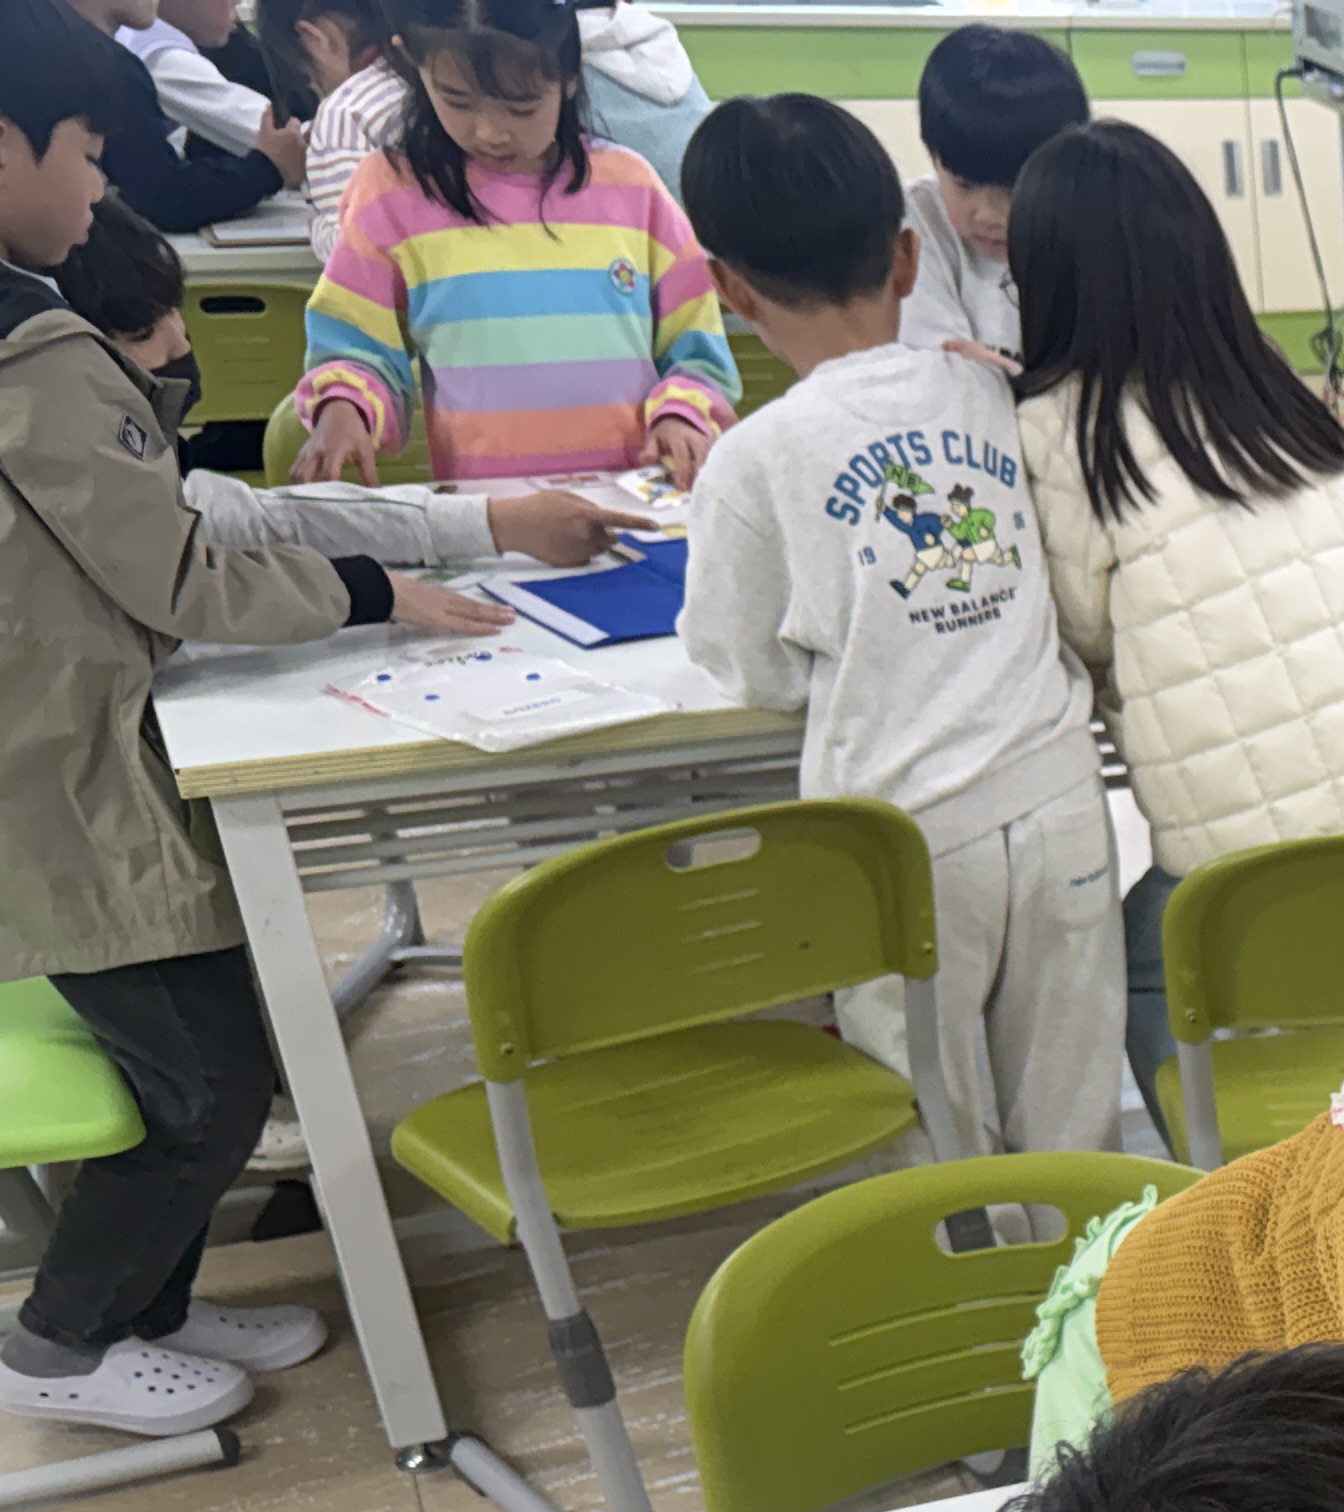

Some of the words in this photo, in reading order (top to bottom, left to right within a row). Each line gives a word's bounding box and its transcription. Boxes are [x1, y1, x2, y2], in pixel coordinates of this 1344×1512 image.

[826, 430, 933, 527] SPORTS
[941, 430, 1018, 489] CLUB
[908, 604, 945, 625] NEW
[949, 586, 1016, 616] BALANCE
[934, 606, 1002, 634] RUNNERS
